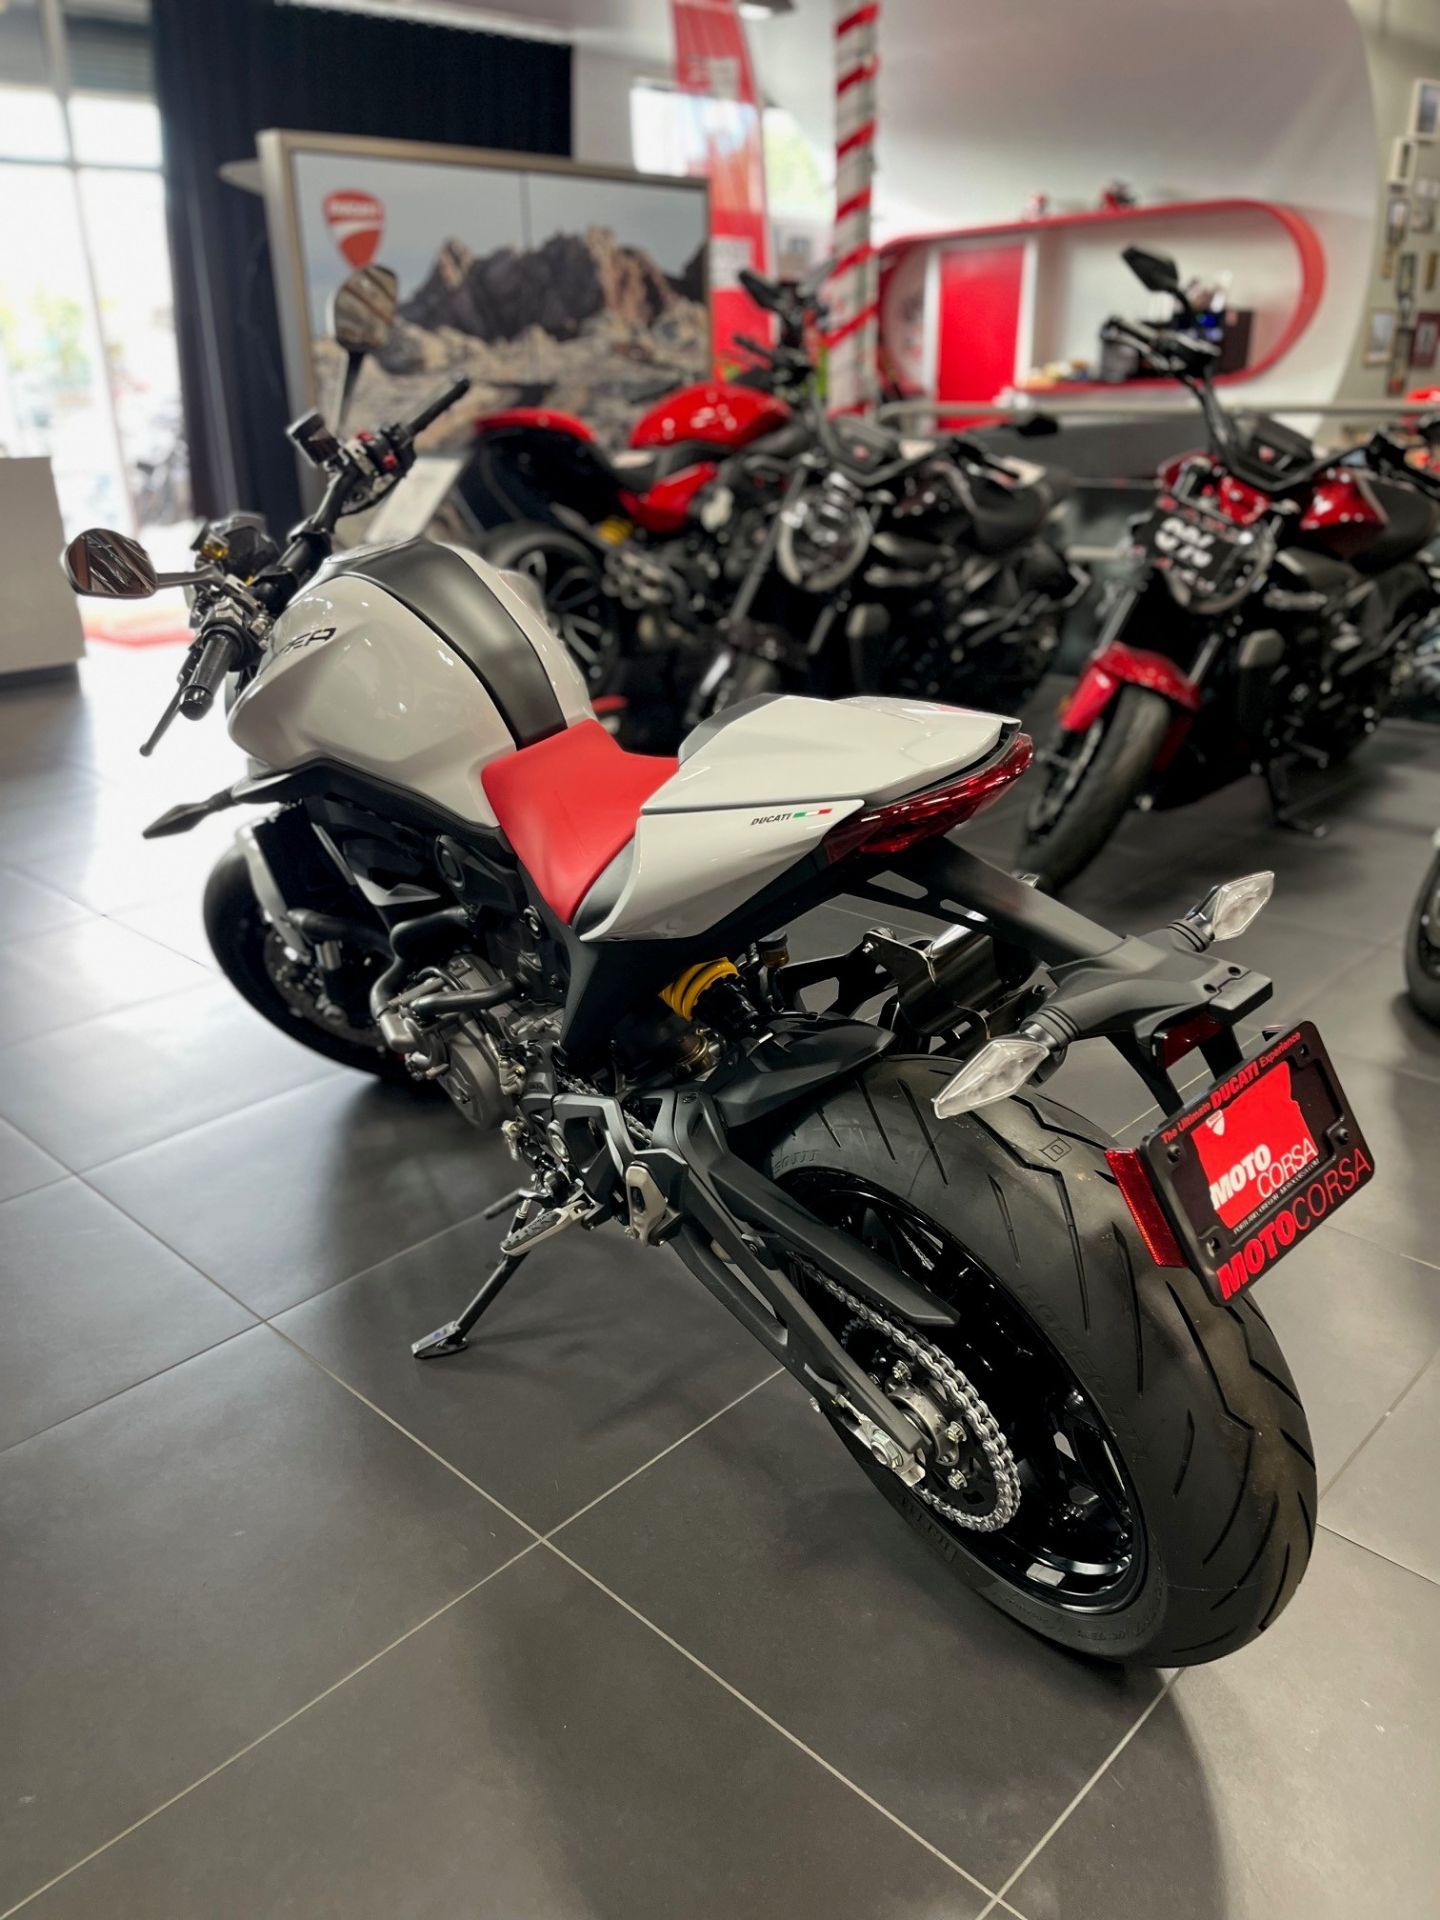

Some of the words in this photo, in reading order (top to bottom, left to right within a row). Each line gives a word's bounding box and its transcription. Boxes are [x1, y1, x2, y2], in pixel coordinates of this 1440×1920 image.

[750, 812, 792, 826] DUCATI
[1161, 1129, 1178, 1144] The
[1177, 1102, 1211, 1132] Ultimate
[1210, 1061, 1260, 1109] DUCATI
[1259, 1031, 1301, 1068] Experience
[1209, 1144, 1271, 1211] MOTO
[1257, 1137, 1319, 1199] CORSA
